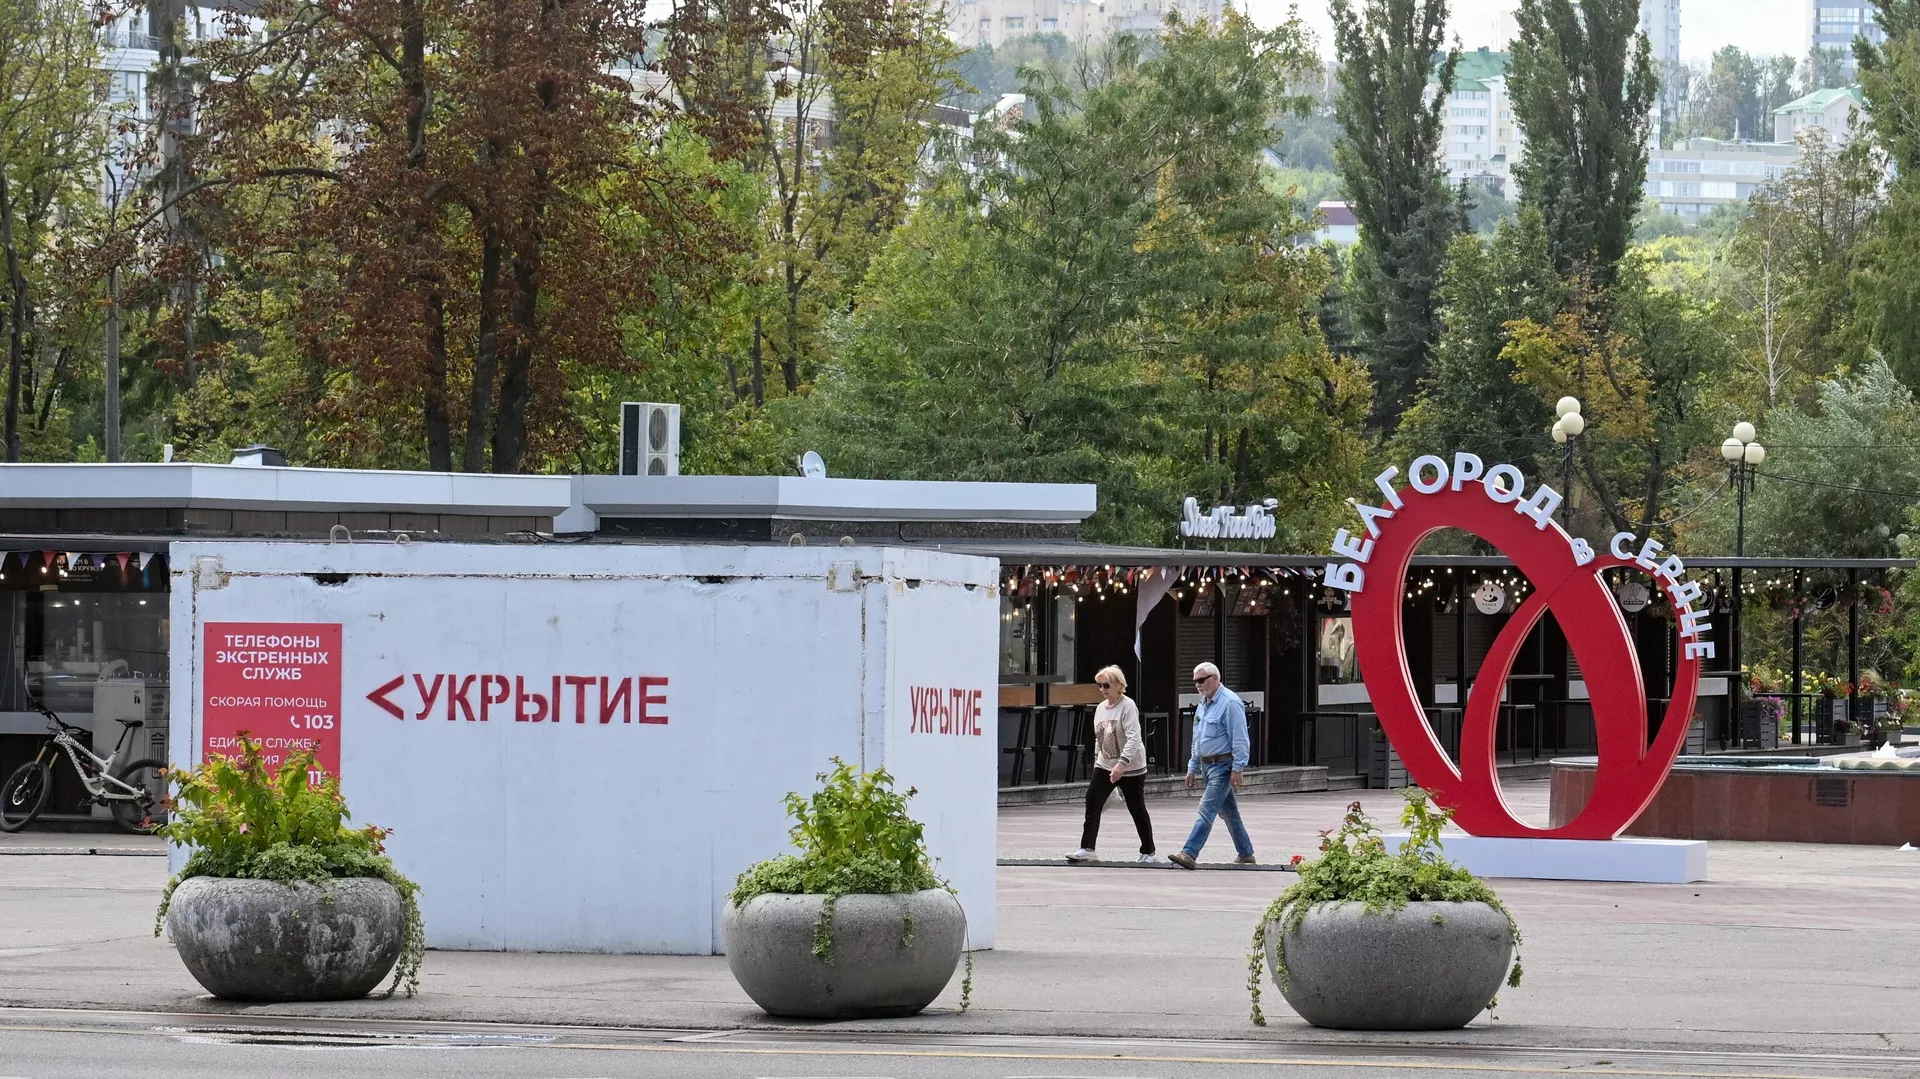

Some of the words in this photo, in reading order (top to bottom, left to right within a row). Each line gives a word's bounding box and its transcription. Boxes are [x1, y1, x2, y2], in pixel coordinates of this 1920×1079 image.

[1322, 452, 1563, 593] БЕЛГОРОД
[1610, 531, 1716, 660] СЕРДЦЕ
[224, 634, 320, 648] ТЕЛЕФОНЫ
[215, 651, 329, 665] ЭКСТРЕННЫХ
[242, 667, 302, 680] СЛУЖБ
[209, 696, 261, 707] СКОРАЯ
[264, 697, 328, 709] ПОМОЩЬ
[411, 673, 669, 725] УКРЫТИЕ
[910, 685, 982, 736] УКРЫТИЕ
[304, 714, 334, 730] 103
